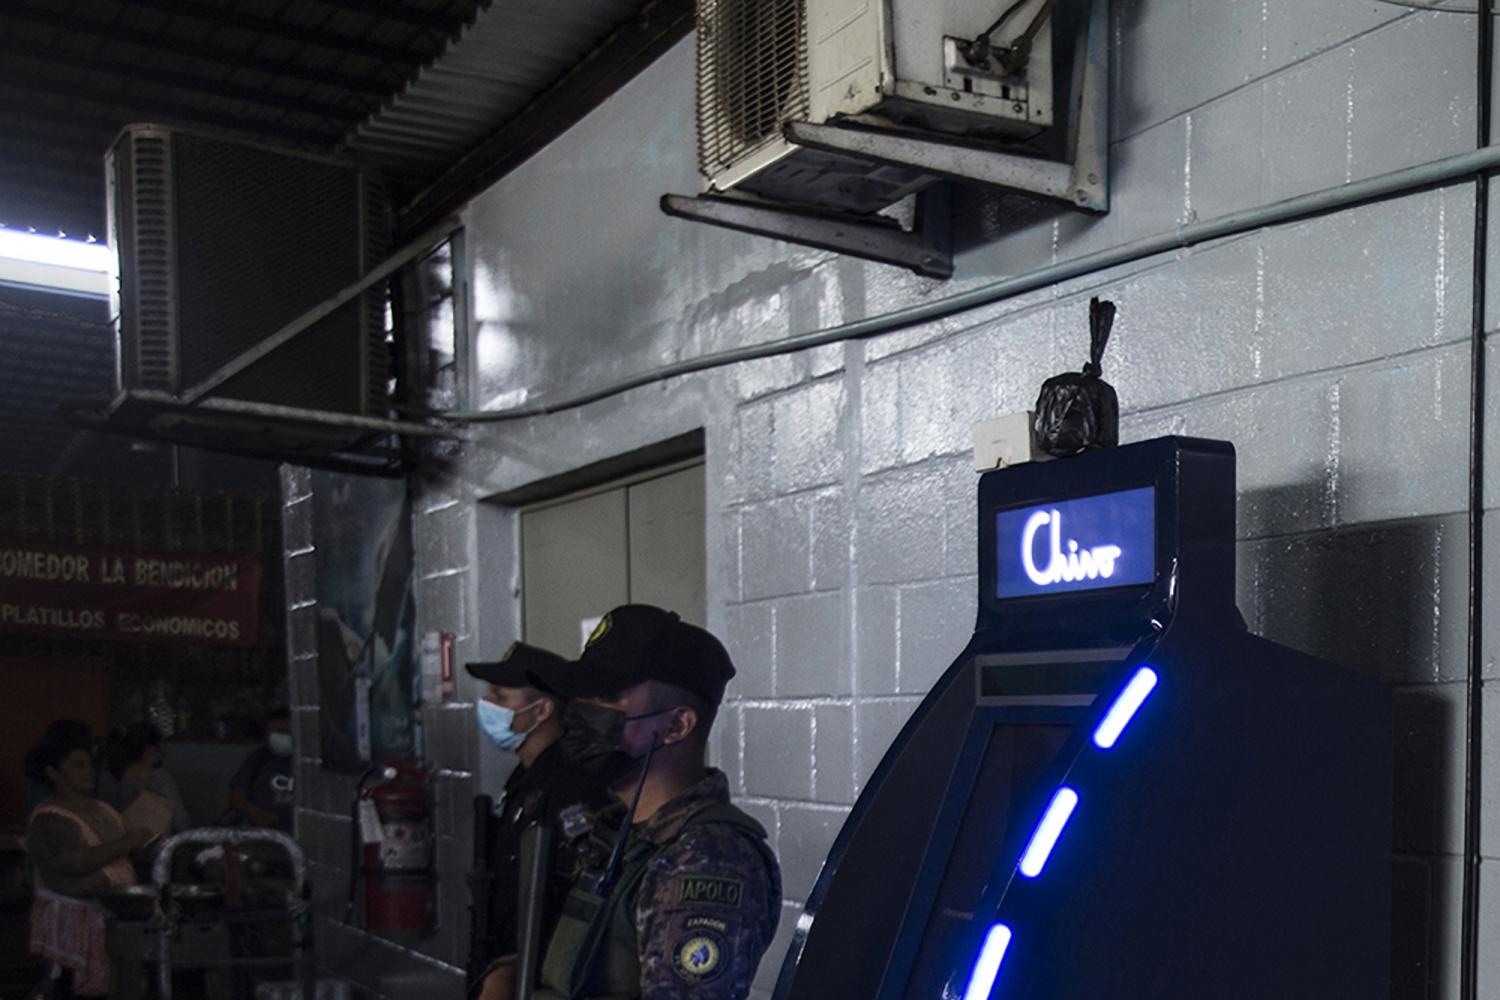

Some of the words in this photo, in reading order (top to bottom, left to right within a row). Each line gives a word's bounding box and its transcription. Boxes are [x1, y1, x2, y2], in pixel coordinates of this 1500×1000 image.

[1020, 508, 1122, 586] Chivo
[0, 550, 91, 583] OMEDOR
[100, 557, 127, 584] LA
[134, 557, 238, 591] BENDICION
[0, 602, 106, 629] PLATILLOS
[117, 612, 241, 640] ECONOMICOS
[683, 879, 739, 905] APOLO
